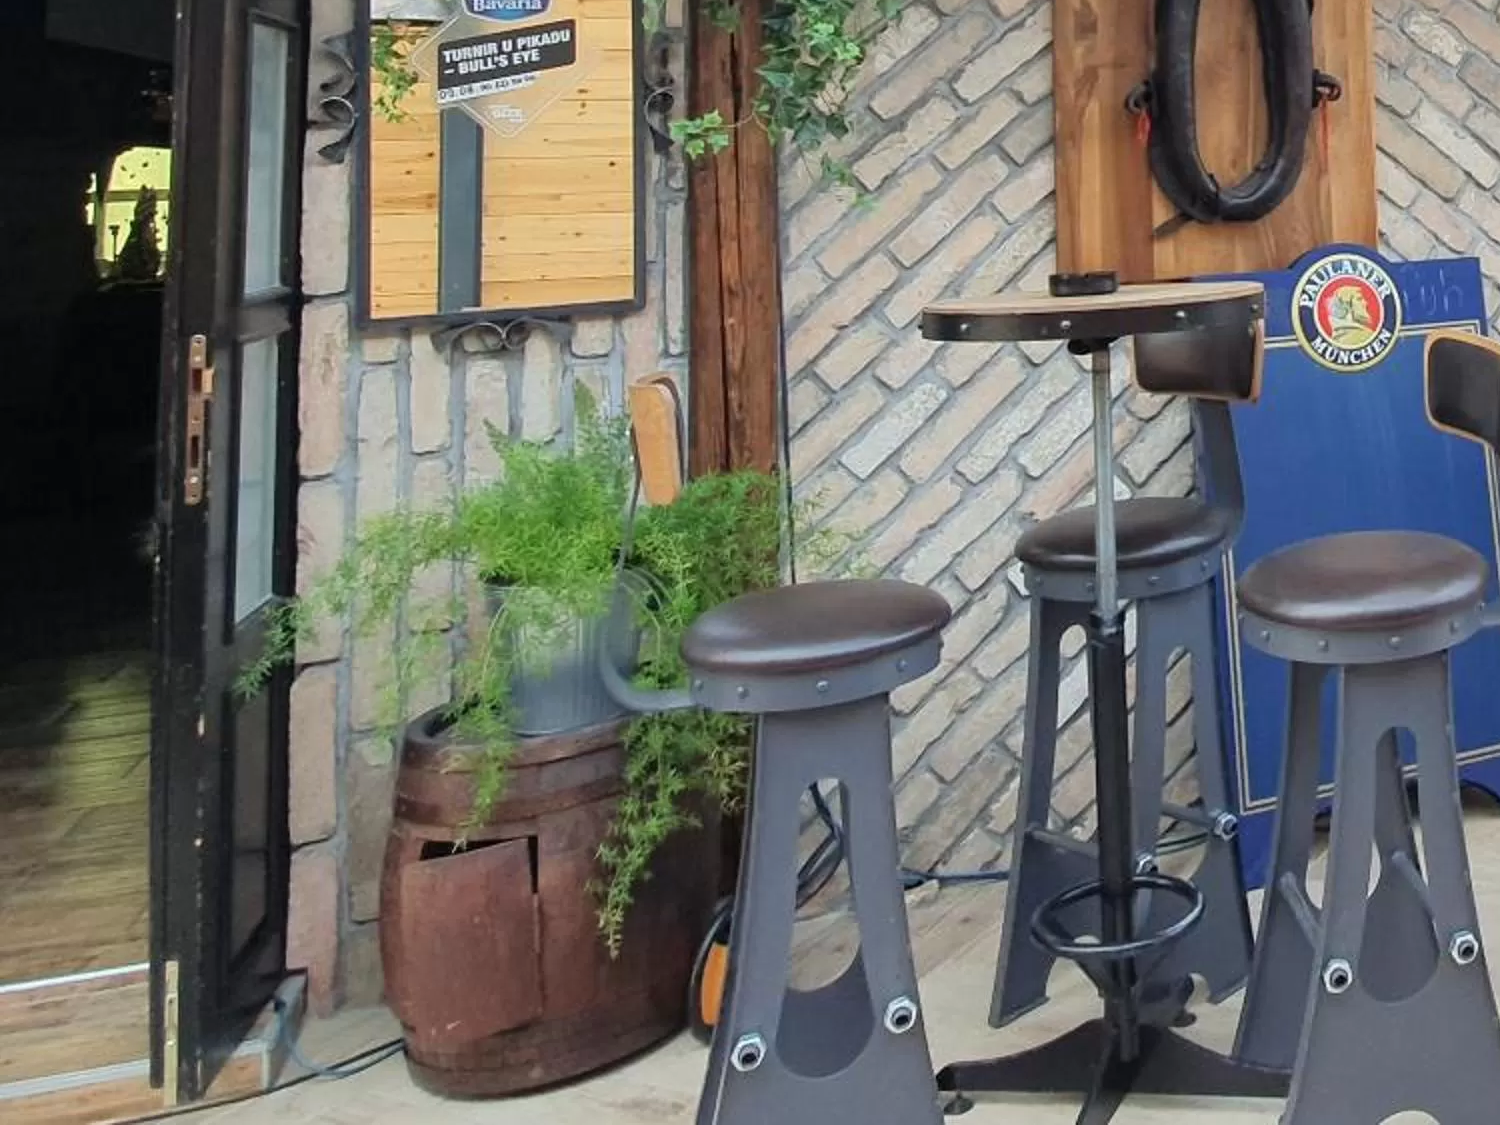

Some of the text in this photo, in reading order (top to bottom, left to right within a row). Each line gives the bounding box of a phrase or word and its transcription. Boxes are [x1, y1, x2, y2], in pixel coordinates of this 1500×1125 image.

[442, 29, 571, 63] TURNIR U PIKADU
[458, 55, 508, 75] BULL'S
[513, 49, 540, 65] EYE
[1300, 260, 1391, 309] PAULANER
